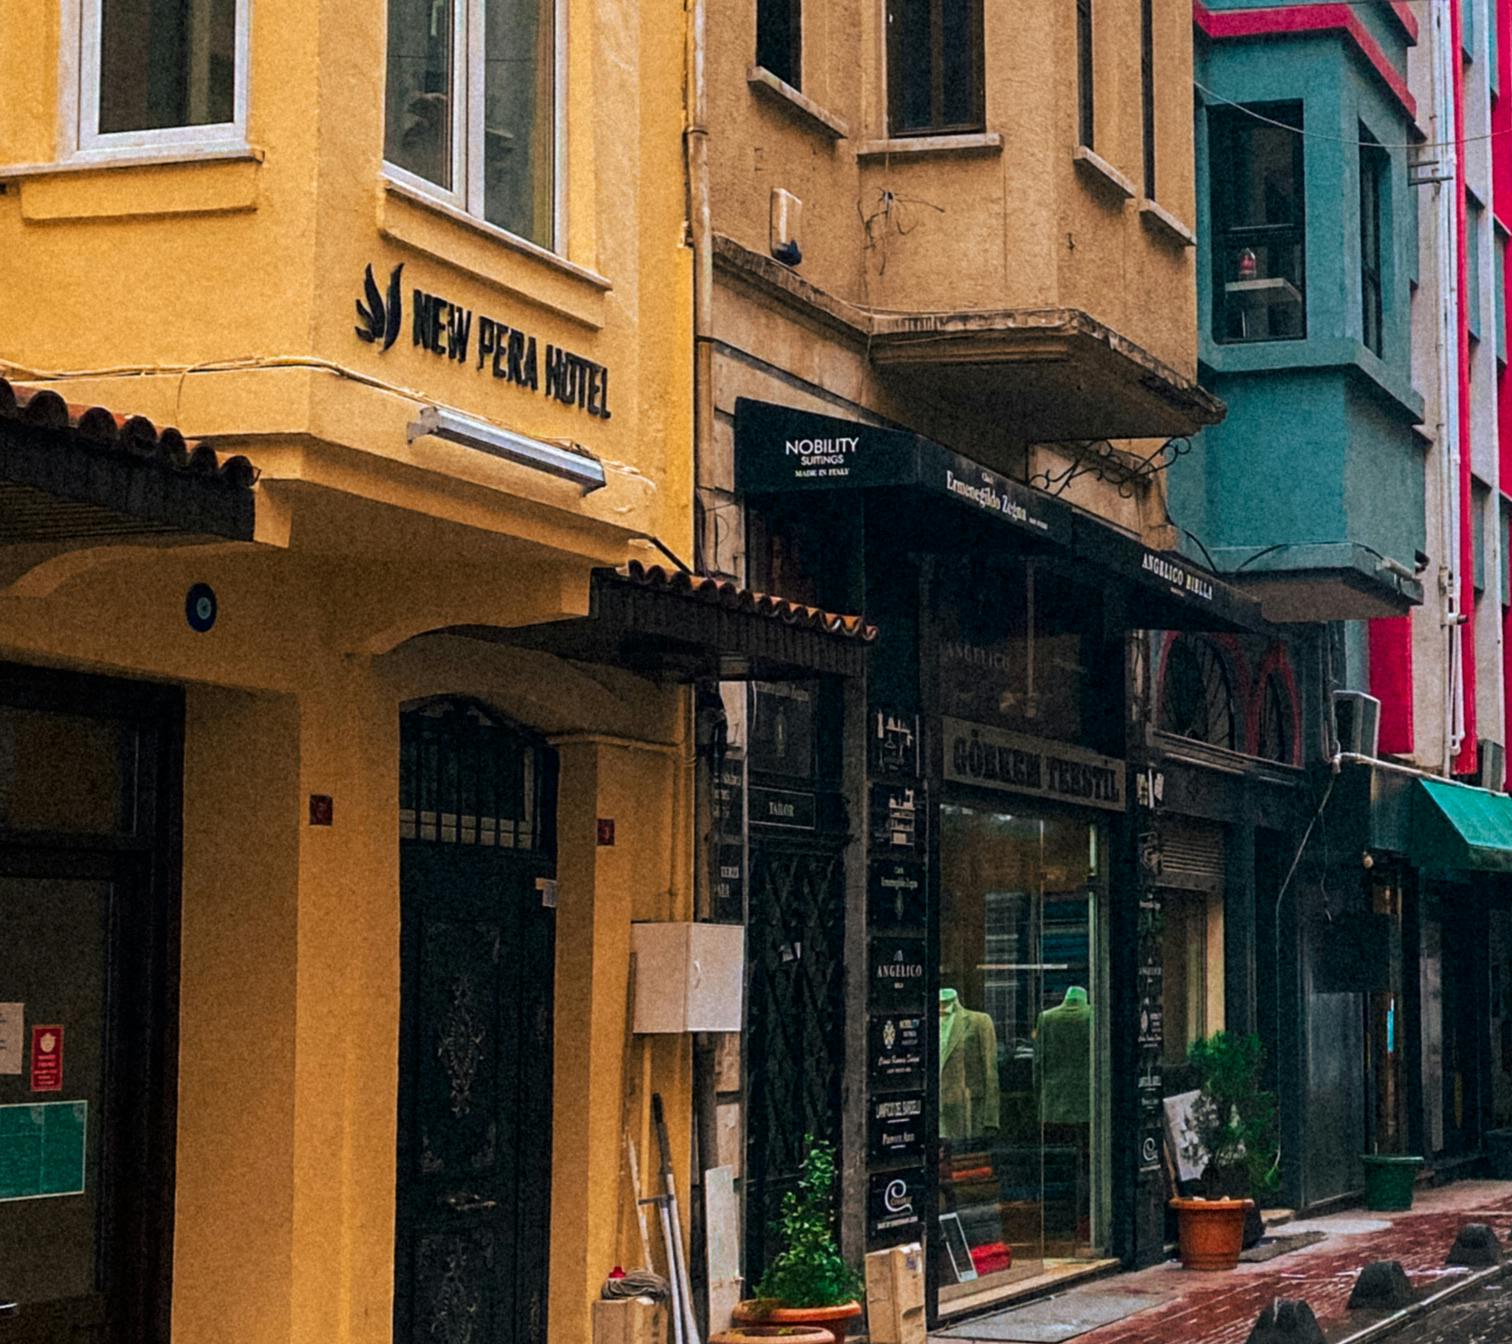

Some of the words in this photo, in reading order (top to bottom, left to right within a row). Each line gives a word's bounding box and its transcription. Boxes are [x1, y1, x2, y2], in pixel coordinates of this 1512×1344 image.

[412, 288, 473, 364] NEW
[476, 315, 539, 392] PERA
[545, 343, 612, 420] HOTEL
[785, 436, 860, 455] NOBILITY
[800, 454, 845, 466] SUITINGS
[1141, 552, 1184, 586] ANGELICO
[877, 963, 923, 978] ANGELICO
